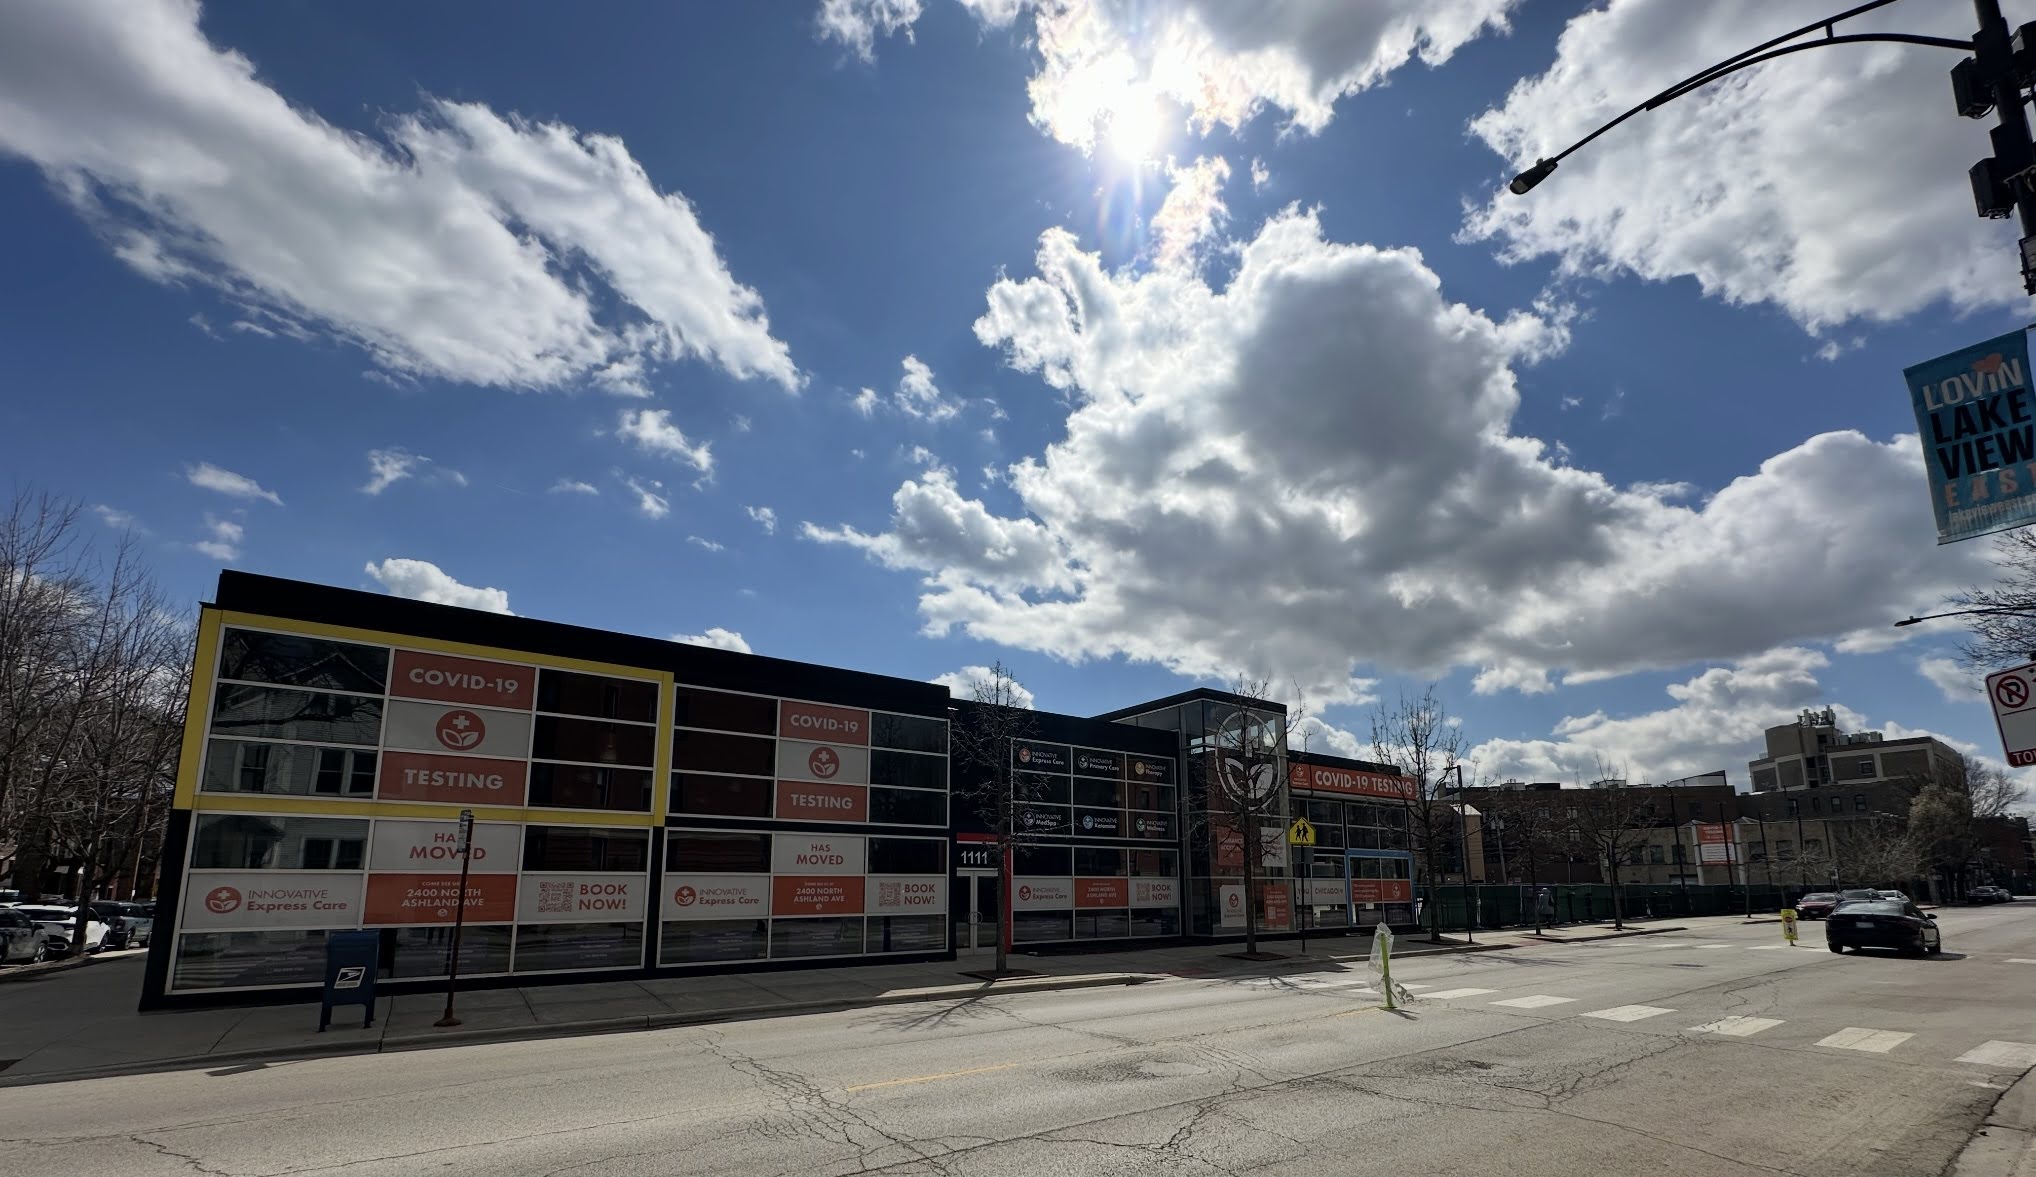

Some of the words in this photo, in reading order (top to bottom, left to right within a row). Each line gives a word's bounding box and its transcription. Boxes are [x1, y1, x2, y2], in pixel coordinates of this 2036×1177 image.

[1930, 387, 2031, 445] LAKE
[1936, 423, 2034, 481] VIEW
[408, 667, 519, 694] COVID-19
[790, 714, 859, 733] COVID-19
[1032, 756, 1052, 765] Express
[1052, 758, 1065, 766] Care
[2012, 750, 2036, 765] TO
[404, 768, 504, 790] TESTING
[1314, 771, 1369, 790] COVID-19
[790, 793, 853, 809] TESTING
[409, 846, 486, 860] MOVD
[811, 843, 831, 852] HAS
[796, 854, 844, 865] MOVED
[960, 850, 988, 865] 1111
[248, 889, 329, 899] INNOVATIVE
[407, 889, 438, 897] 2400
[440, 888, 481, 897] NOTH
[580, 884, 627, 895] BOOK
[699, 888, 747, 896] INNOVATIVE
[796, 887, 816, 895] 2400
[816, 887, 843, 895] NORTH
[904, 884, 935, 893] BOOK
[1297, 887, 1309, 895] YU
[699, 897, 736, 906] Express
[738, 896, 760, 904] Care
[793, 895, 830, 903] ASHLAND
[904, 895, 935, 905] NOW!
[1055, 892, 1067, 900] Care
[247, 901, 307, 913] Express
[312, 900, 347, 910] Care
[401, 898, 459, 908] ASHLAND
[462, 898, 486, 907] AVE
[579, 898, 626, 910] NOW!
